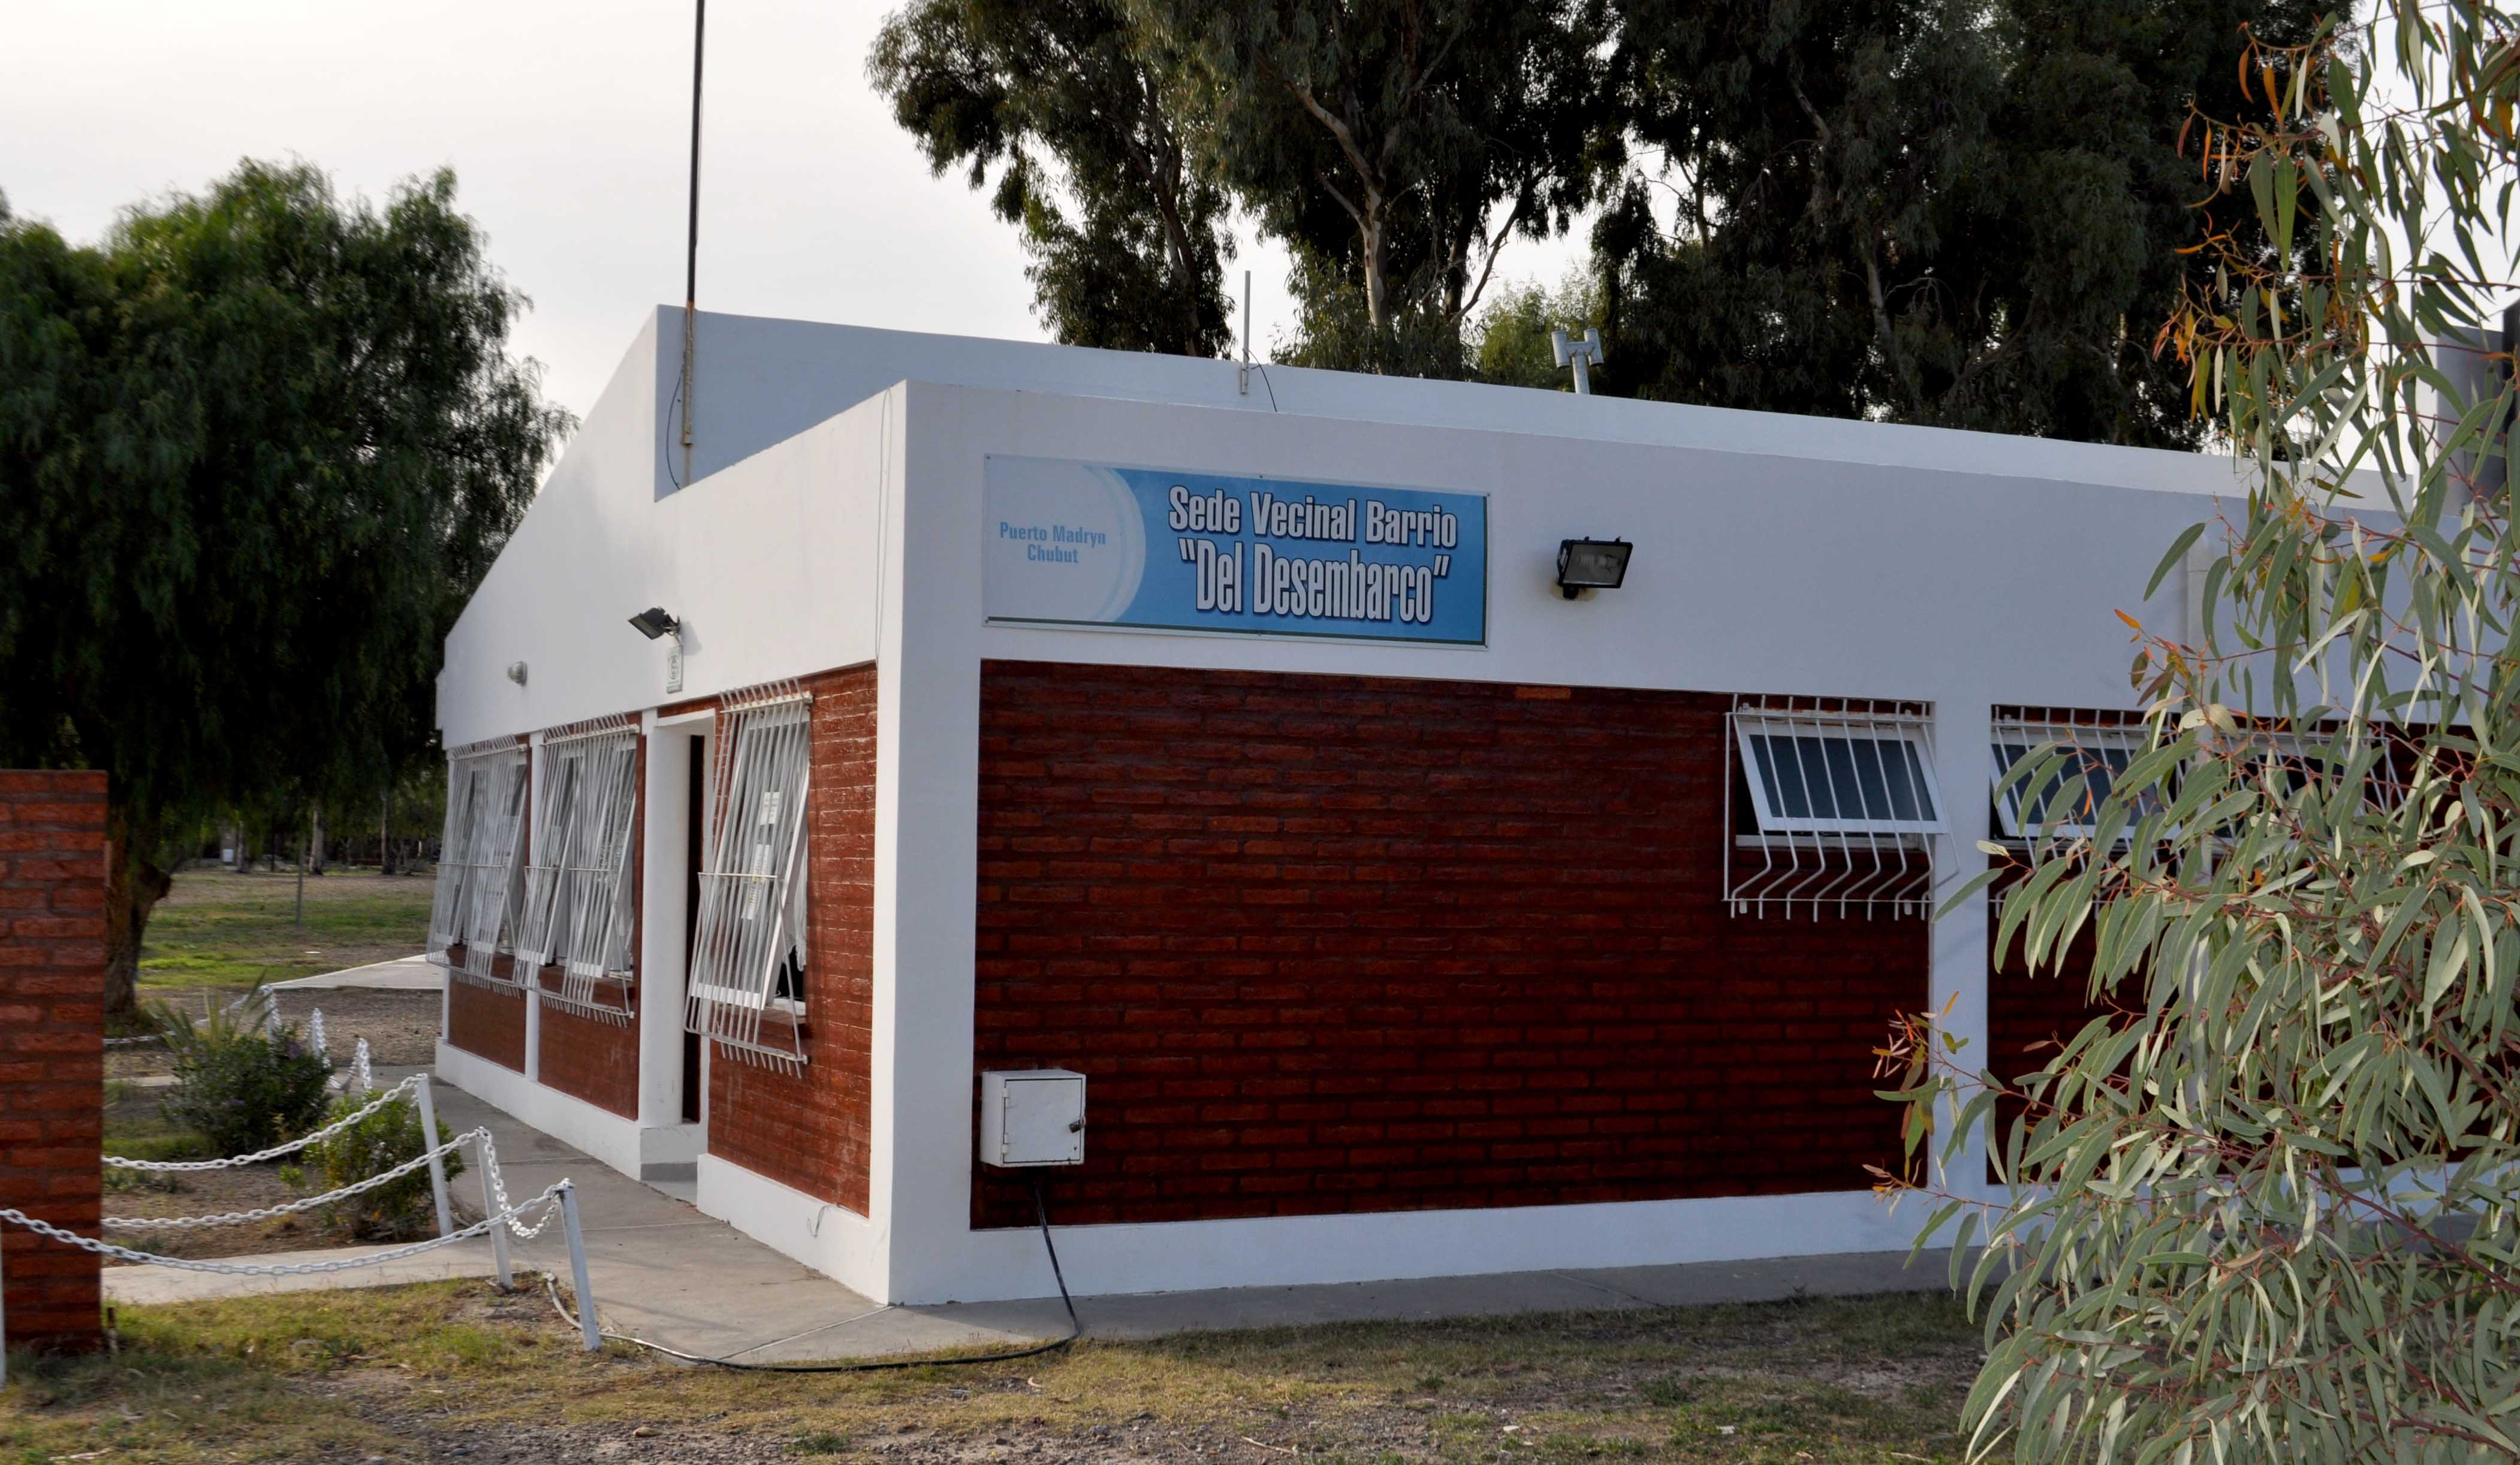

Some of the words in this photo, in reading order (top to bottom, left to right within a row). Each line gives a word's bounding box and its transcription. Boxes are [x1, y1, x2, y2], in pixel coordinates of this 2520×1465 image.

[1169, 485, 1241, 534] Sede
[1250, 492, 1356, 541] Vecinal
[1365, 499, 1457, 548] Barrio
[1000, 522, 1047, 541] Puerto
[1053, 525, 1106, 548] Madryn
[1027, 544, 1078, 563] Chubut
